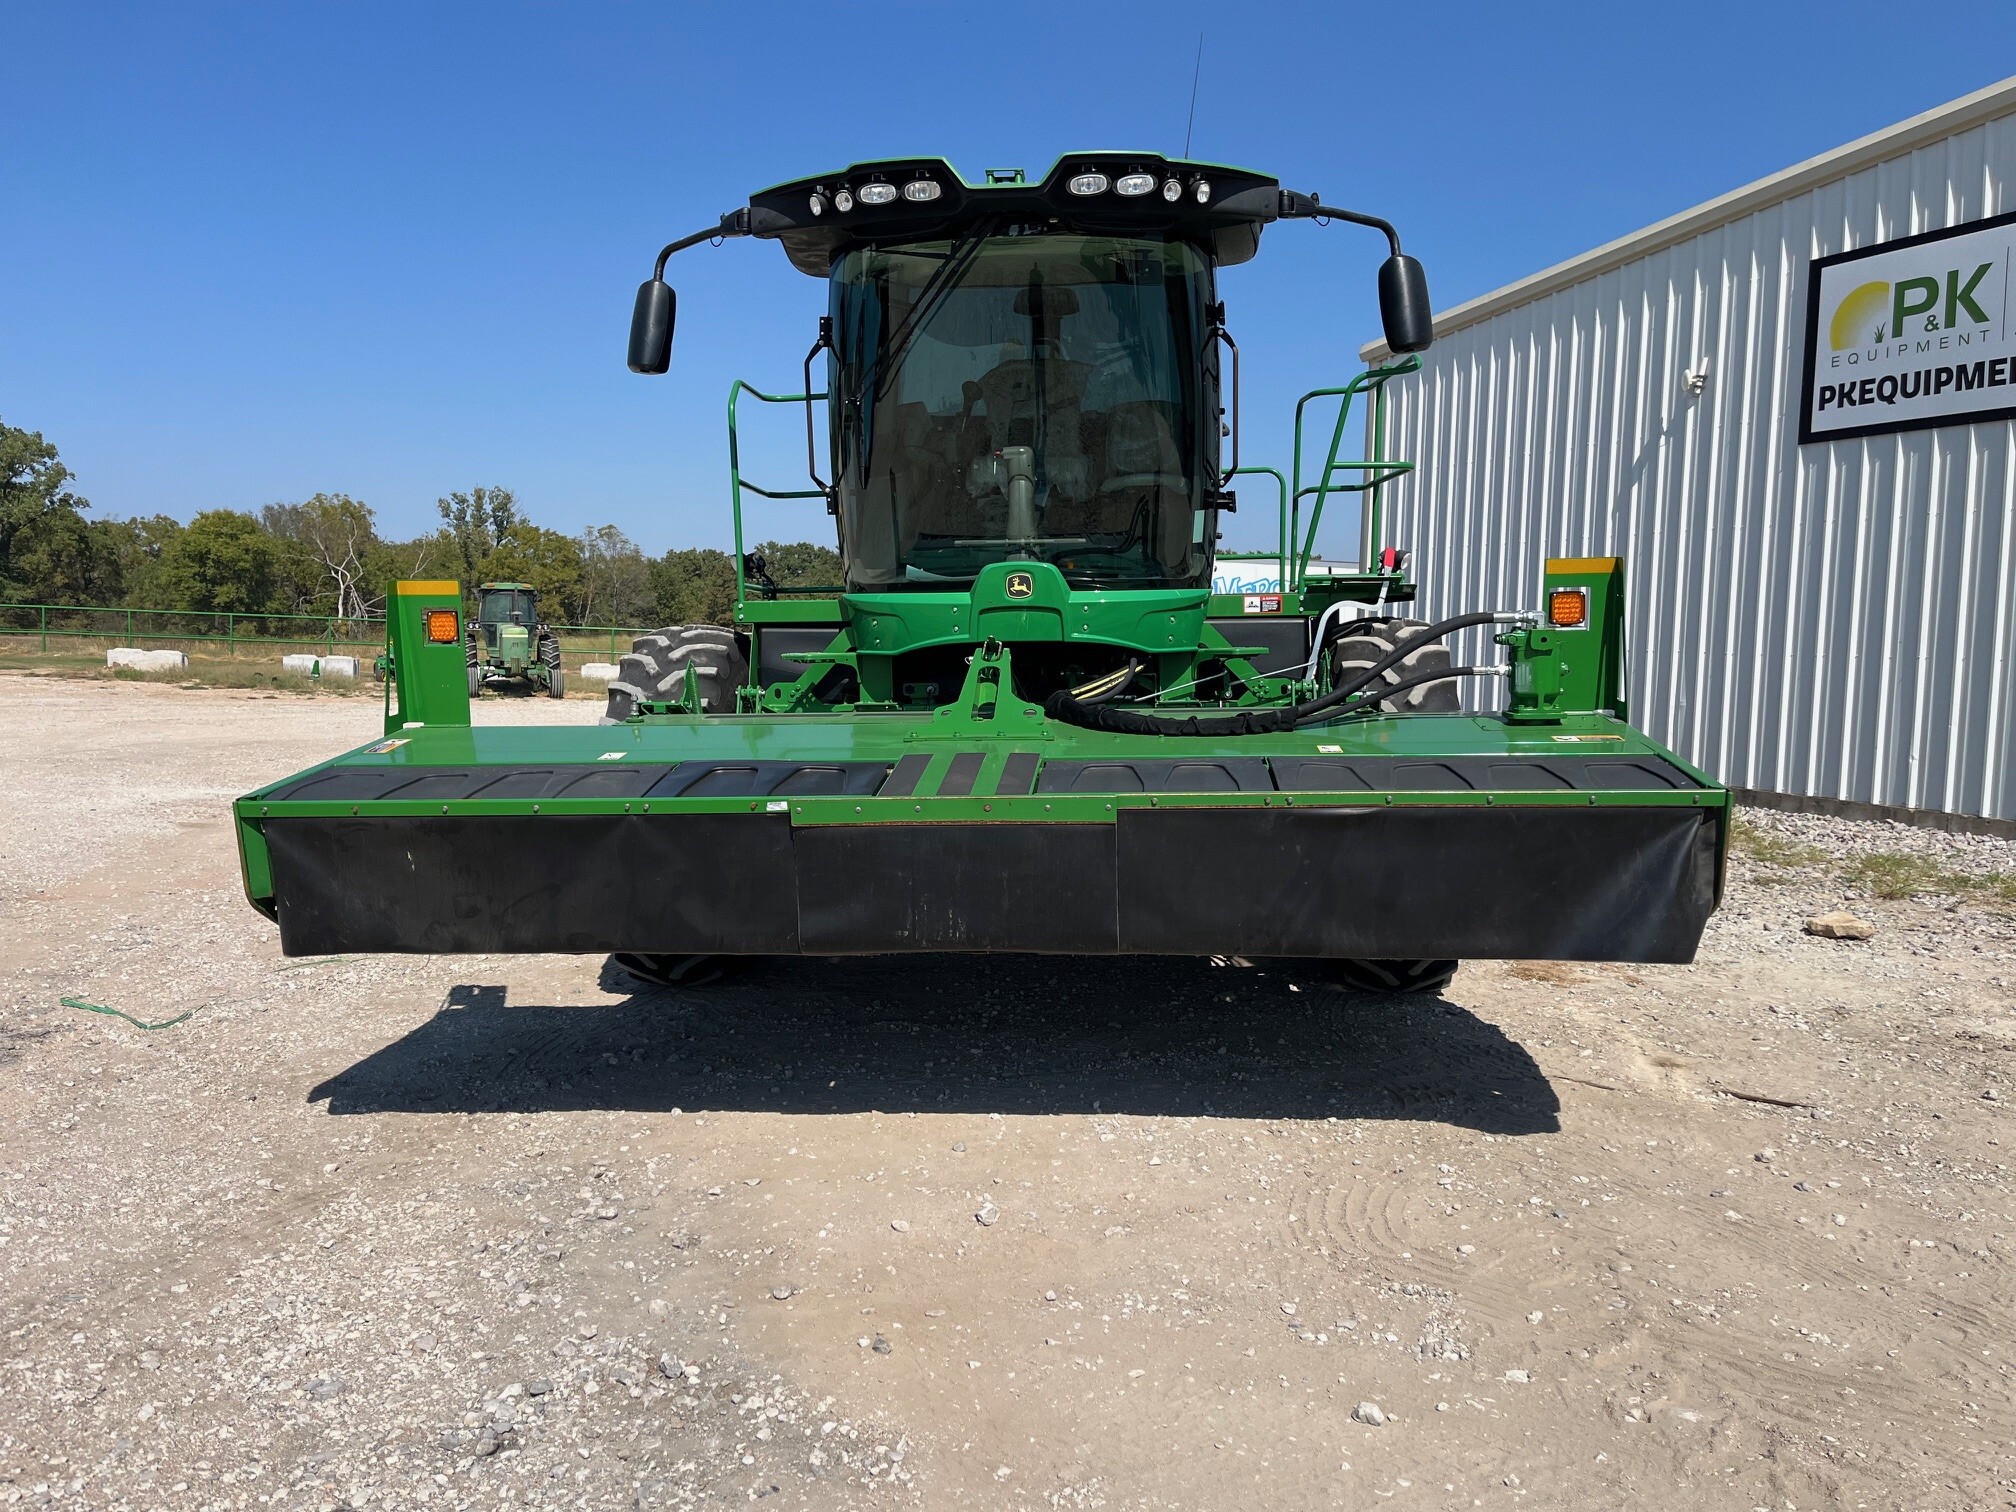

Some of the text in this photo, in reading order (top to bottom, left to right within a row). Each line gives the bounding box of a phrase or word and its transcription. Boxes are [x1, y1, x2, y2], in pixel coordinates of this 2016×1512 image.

[1892, 262, 1993, 338] P&K
[1831, 330, 1990, 367] EQUIPMENT
[1818, 356, 2016, 411] PKEQUIPME
